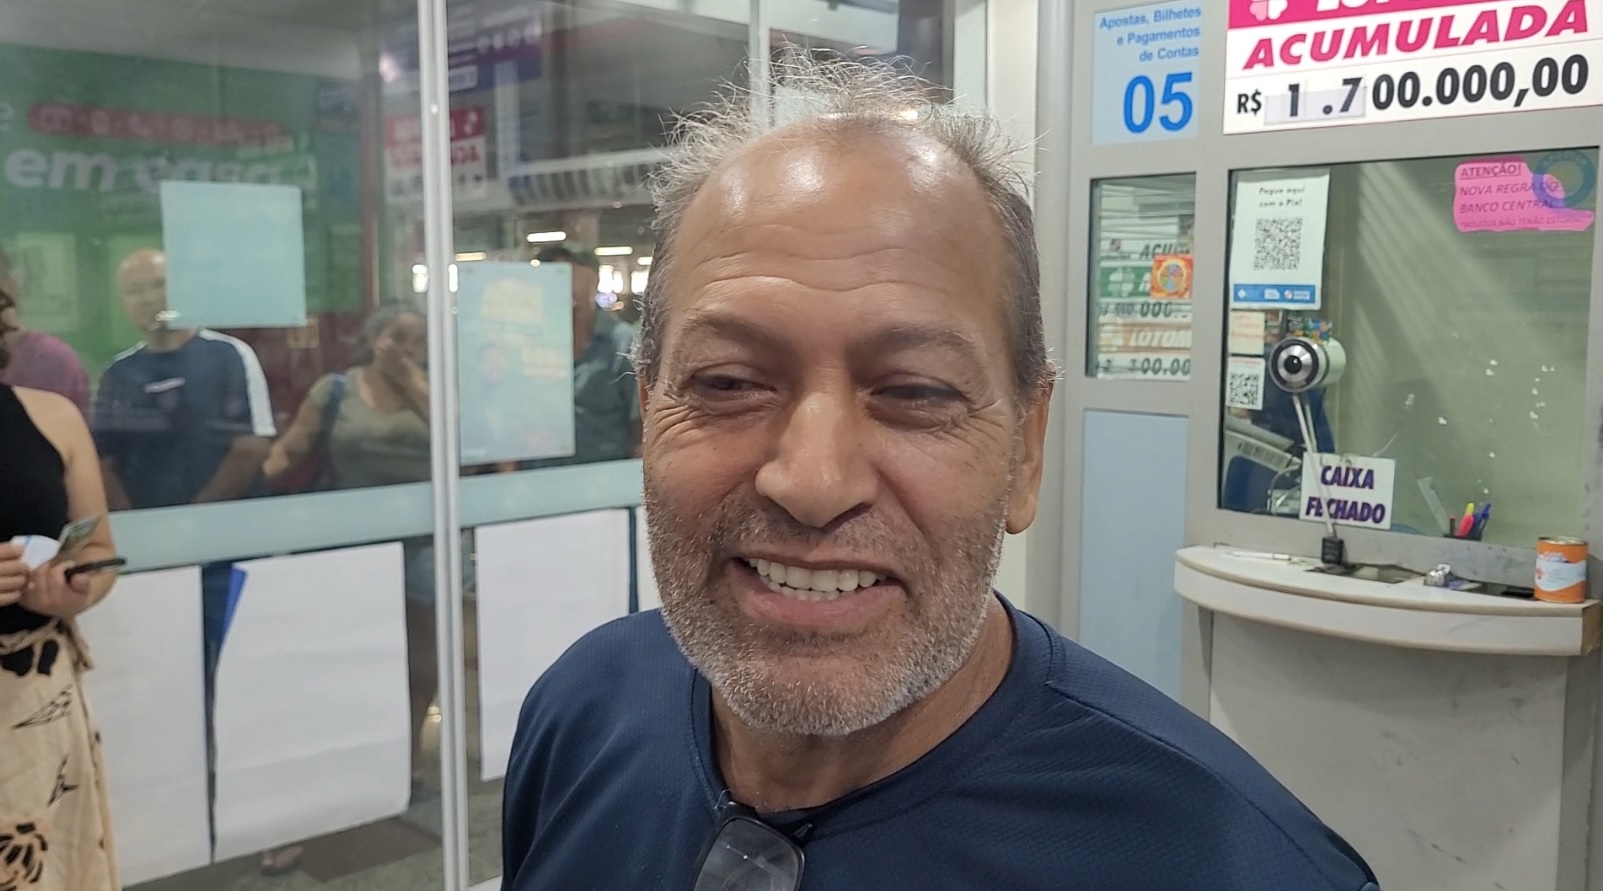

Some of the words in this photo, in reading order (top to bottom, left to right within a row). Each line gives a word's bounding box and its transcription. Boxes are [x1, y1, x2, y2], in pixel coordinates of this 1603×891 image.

[1153, 7, 1202, 22] Bilhetes
[1117, 36, 1123, 46] e
[1127, 27, 1200, 45] Pagamentos
[1242, 0, 1589, 70] ACUMULADA
[1139, 50, 1153, 61] de
[1157, 46, 1199, 60] Contas
[1123, 71, 1193, 134] 05
[1237, 89, 1262, 116] R$
[5, 147, 117, 191] em
[1460, 184, 1493, 197] NOVA
[1460, 201, 1499, 214] BANCO
[1321, 465, 1374, 489] CAIXA
